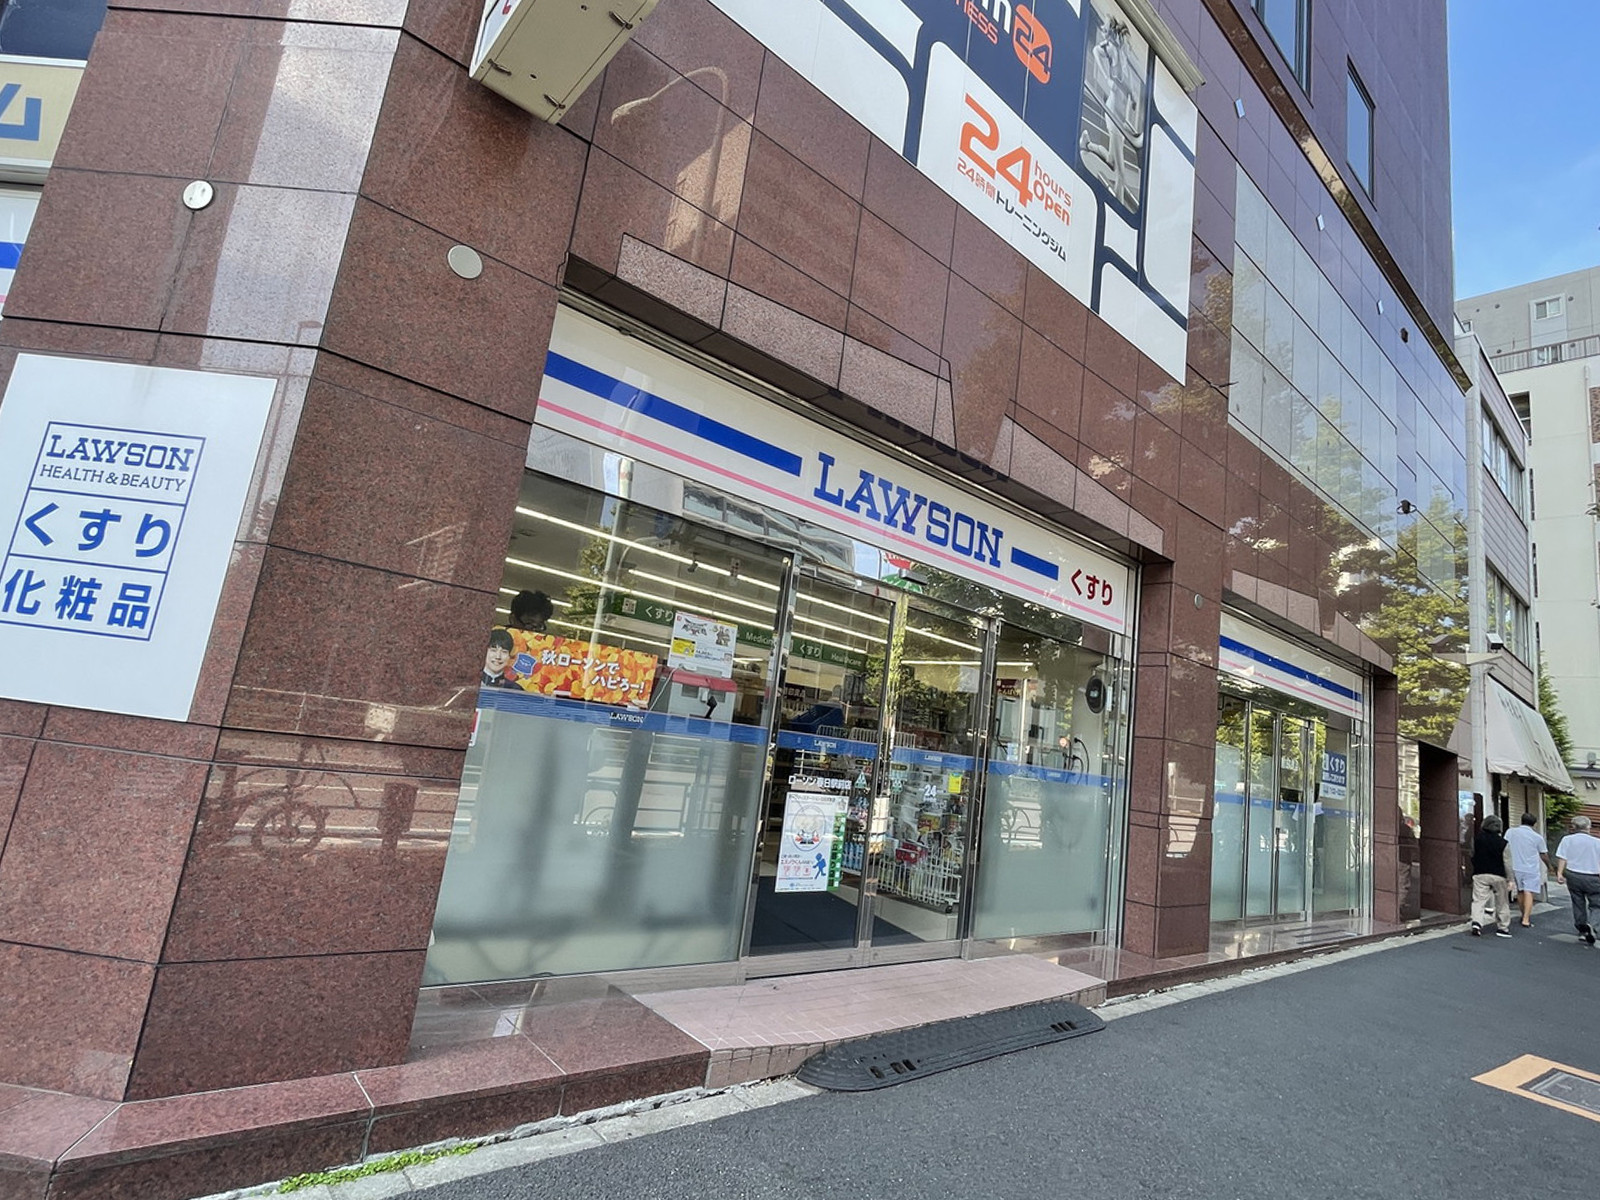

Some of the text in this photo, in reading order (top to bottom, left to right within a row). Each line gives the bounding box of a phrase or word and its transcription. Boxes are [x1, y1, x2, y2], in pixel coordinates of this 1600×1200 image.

[959, 92, 1033, 208] 24
[1034, 159, 1072, 207] hours
[957, 156, 1067, 262] 24時間トレーニングジム
[1032, 182, 1071, 226] Open
[46, 434, 195, 472] LAWSON
[39, 464, 105, 484] HEALTH
[119, 473, 187, 492] BEAUTY
[813, 451, 1004, 568] LAWSON
[24, 502, 172, 558] くすり
[1, 568, 153, 630] 化粧品
[1070, 568, 1113, 606] くすり
[645, 605, 674, 622] くすり
[541, 649, 620, 674] 秋ローソンで
[799, 643, 822, 658] くすり
[609, 711, 644, 724] LAWSON
[1330, 756, 1346, 774] くすり
[924, 784, 937, 797] 24
